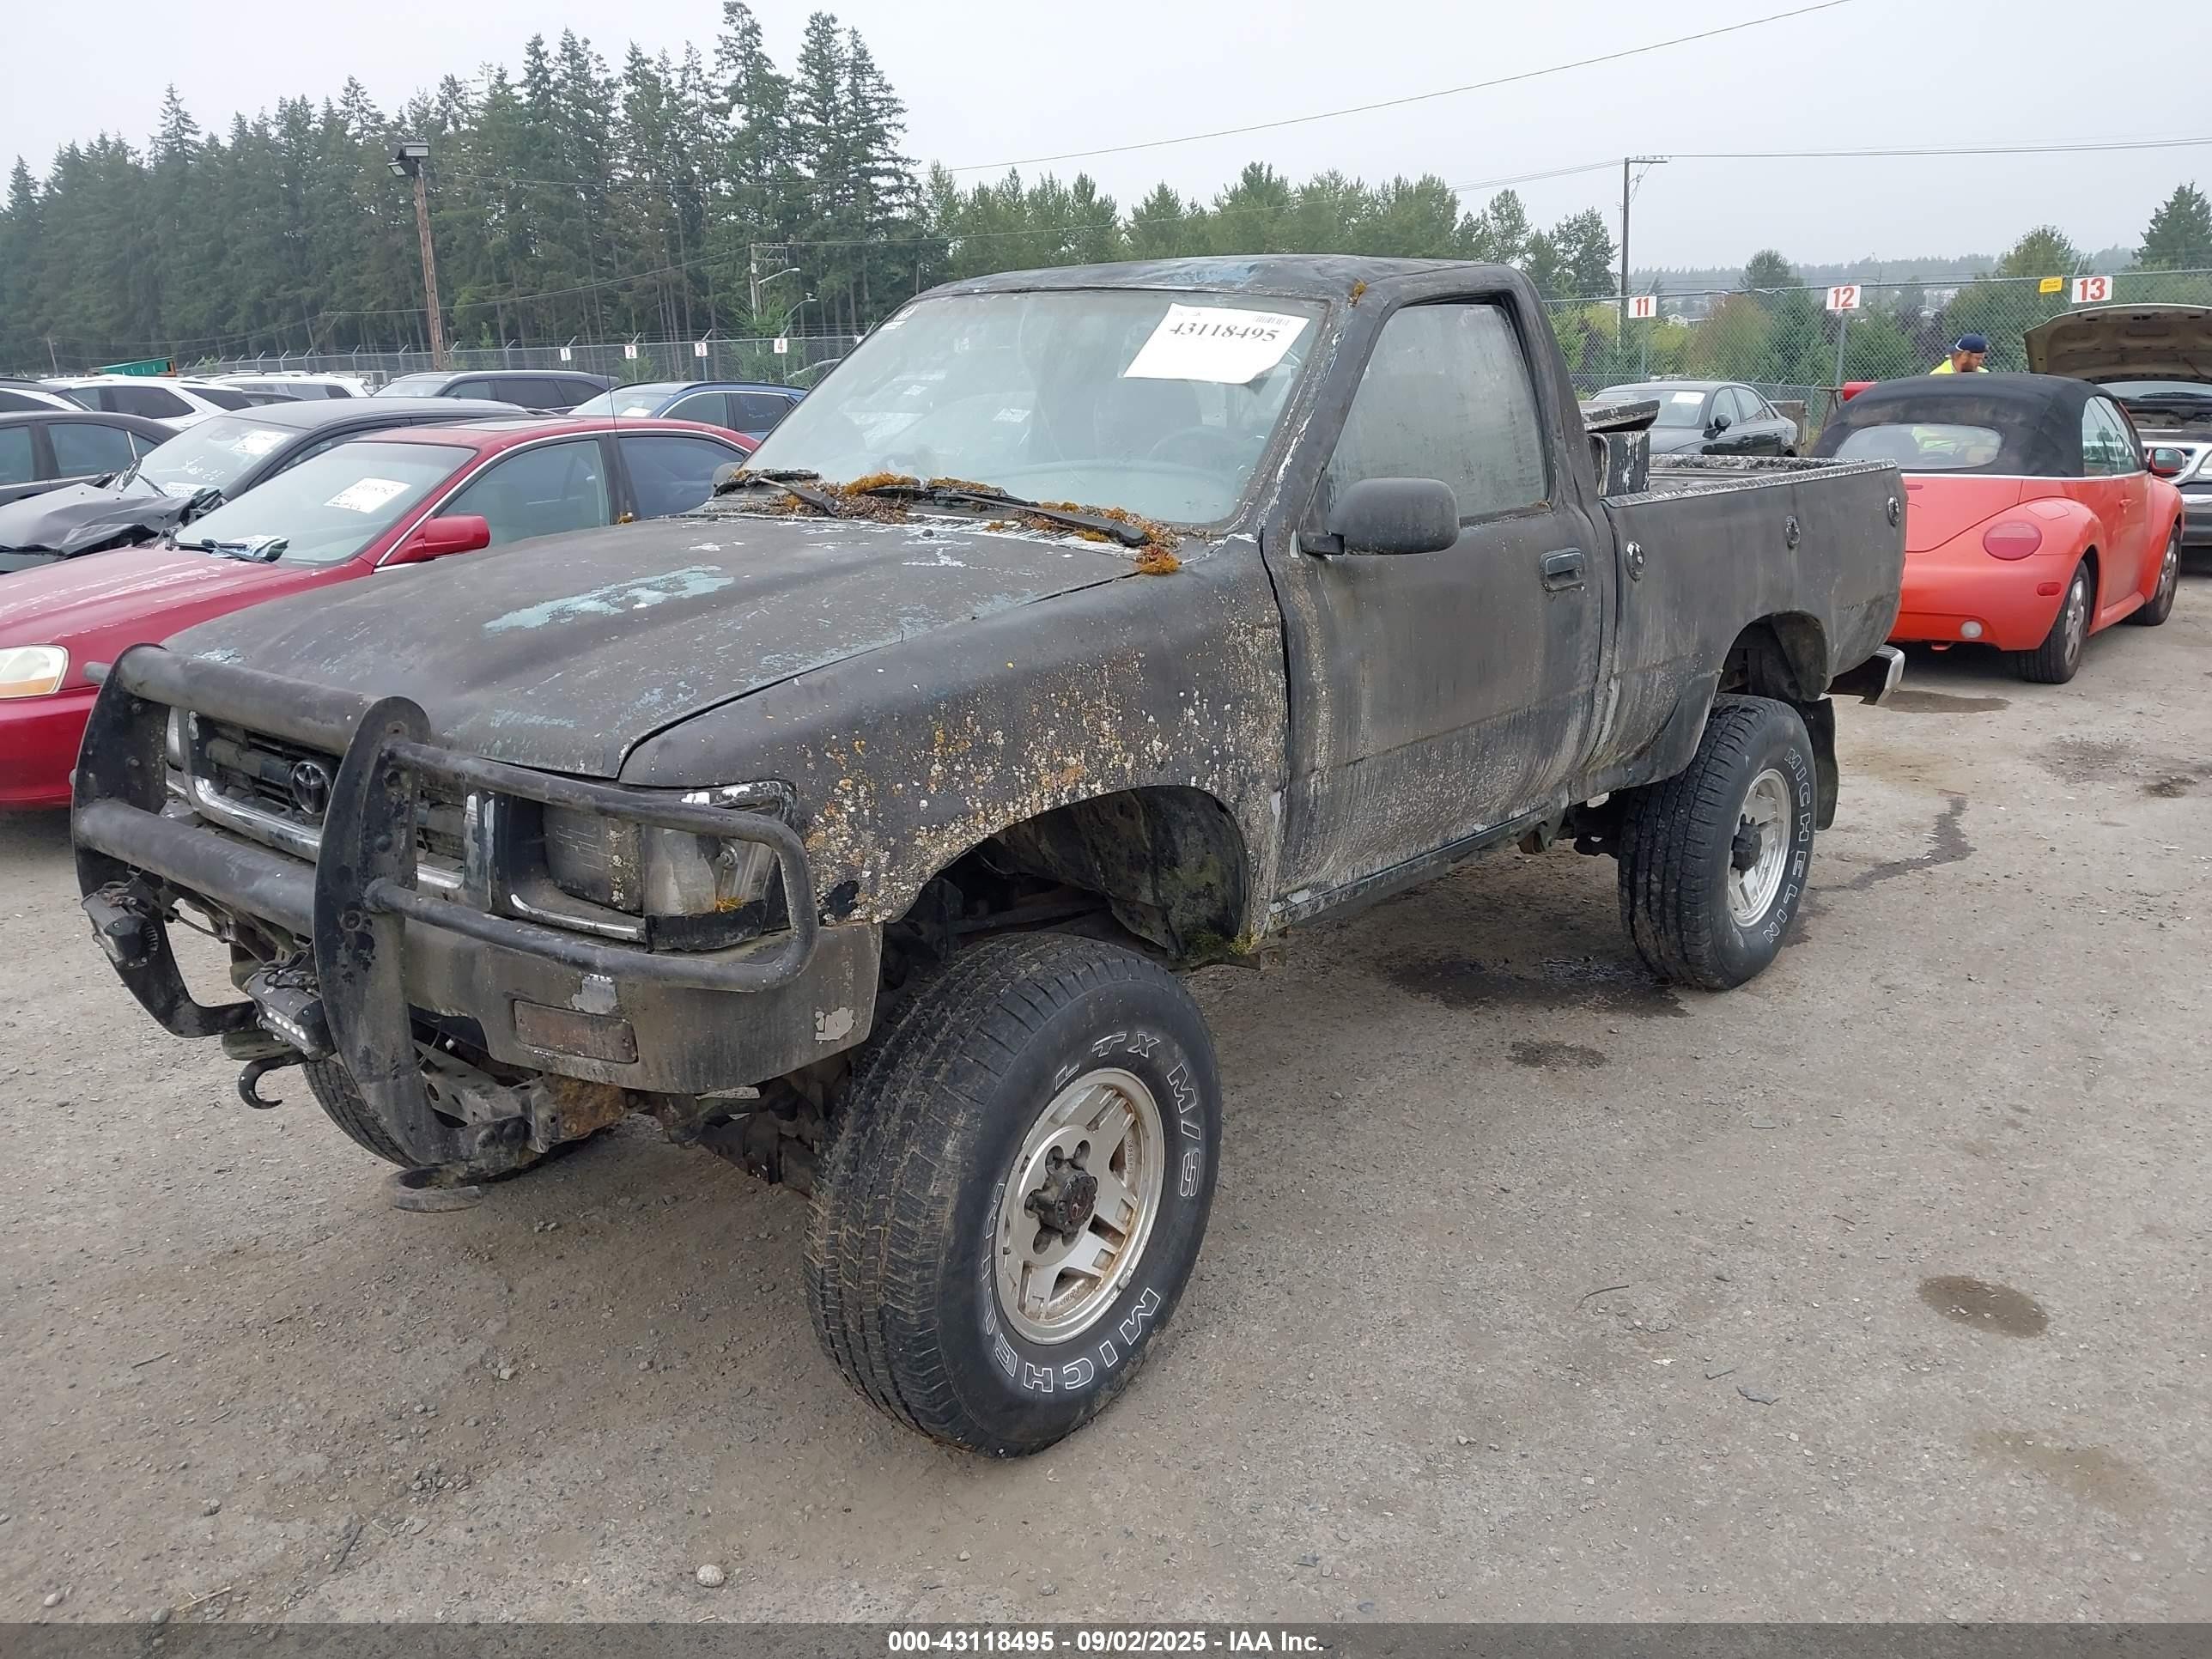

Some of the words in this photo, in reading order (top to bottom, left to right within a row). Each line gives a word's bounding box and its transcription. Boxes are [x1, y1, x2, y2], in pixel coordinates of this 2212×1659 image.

[1833, 287, 1856, 308] 12
[2080, 277, 2106, 301] 13
[1635, 297, 1650, 316] 11
[1170, 322, 1280, 342] 43118495
[628, 346, 635, 358] 2
[698, 343, 704, 357] 3
[777, 339, 784, 352] 4
[1763, 748, 1811, 944] MICHELIN
[1166, 1062, 1201, 1197] M/S
[981, 1183, 1161, 1393] MICHELIN
